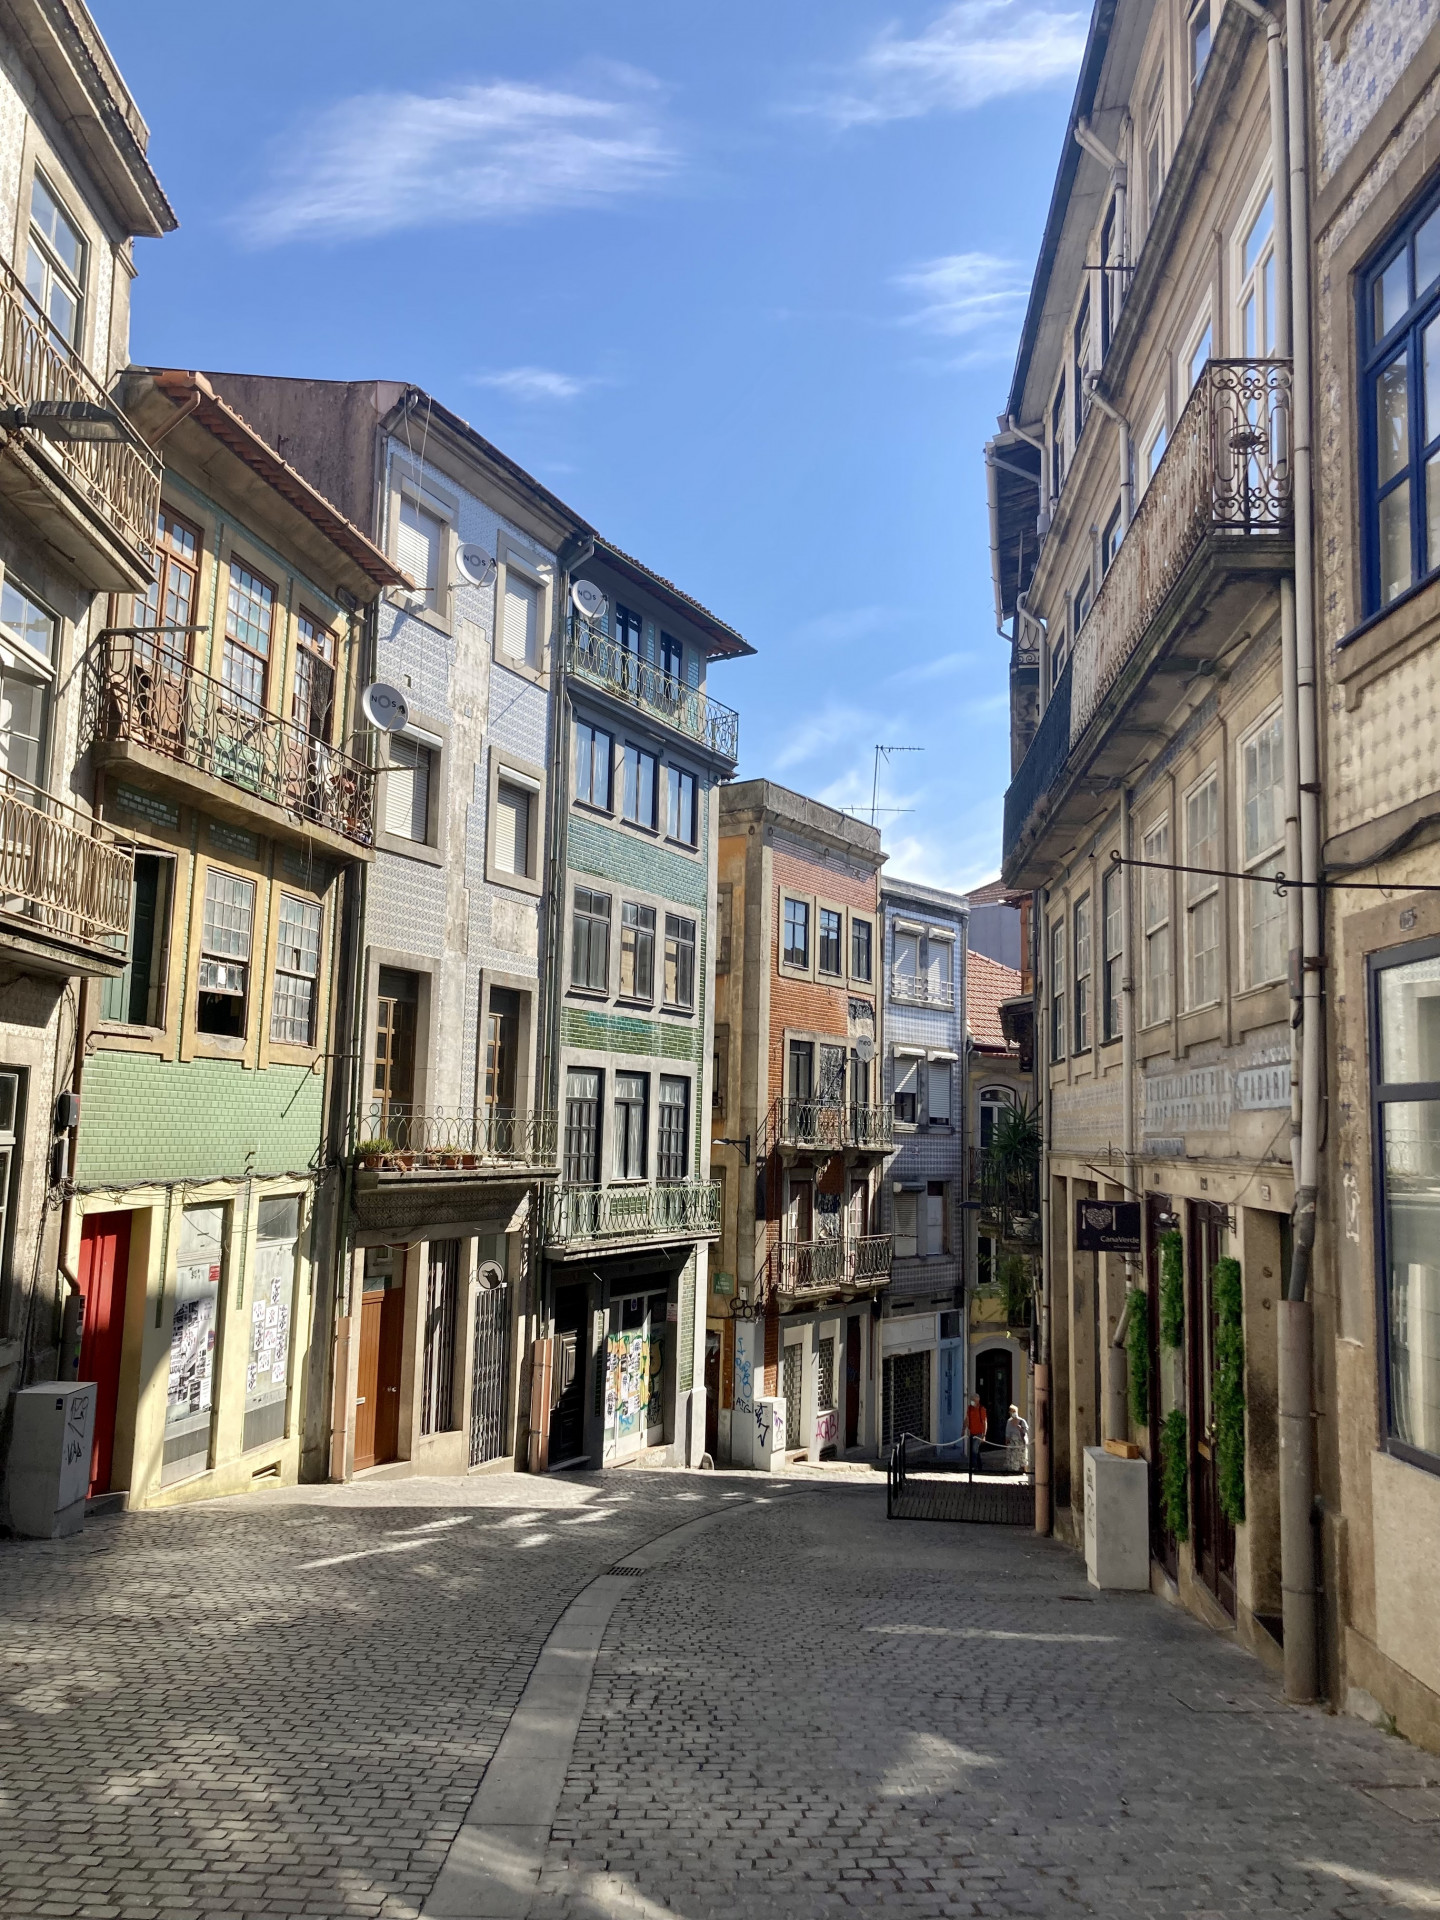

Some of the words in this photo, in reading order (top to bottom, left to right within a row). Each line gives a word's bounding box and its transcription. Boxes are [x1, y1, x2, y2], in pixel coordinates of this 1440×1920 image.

[463, 554, 486, 567] NOS
[578, 590, 597, 601] NOS
[371, 694, 397, 709] NOS
[1100, 1235, 1139, 1244] CanaVerde
